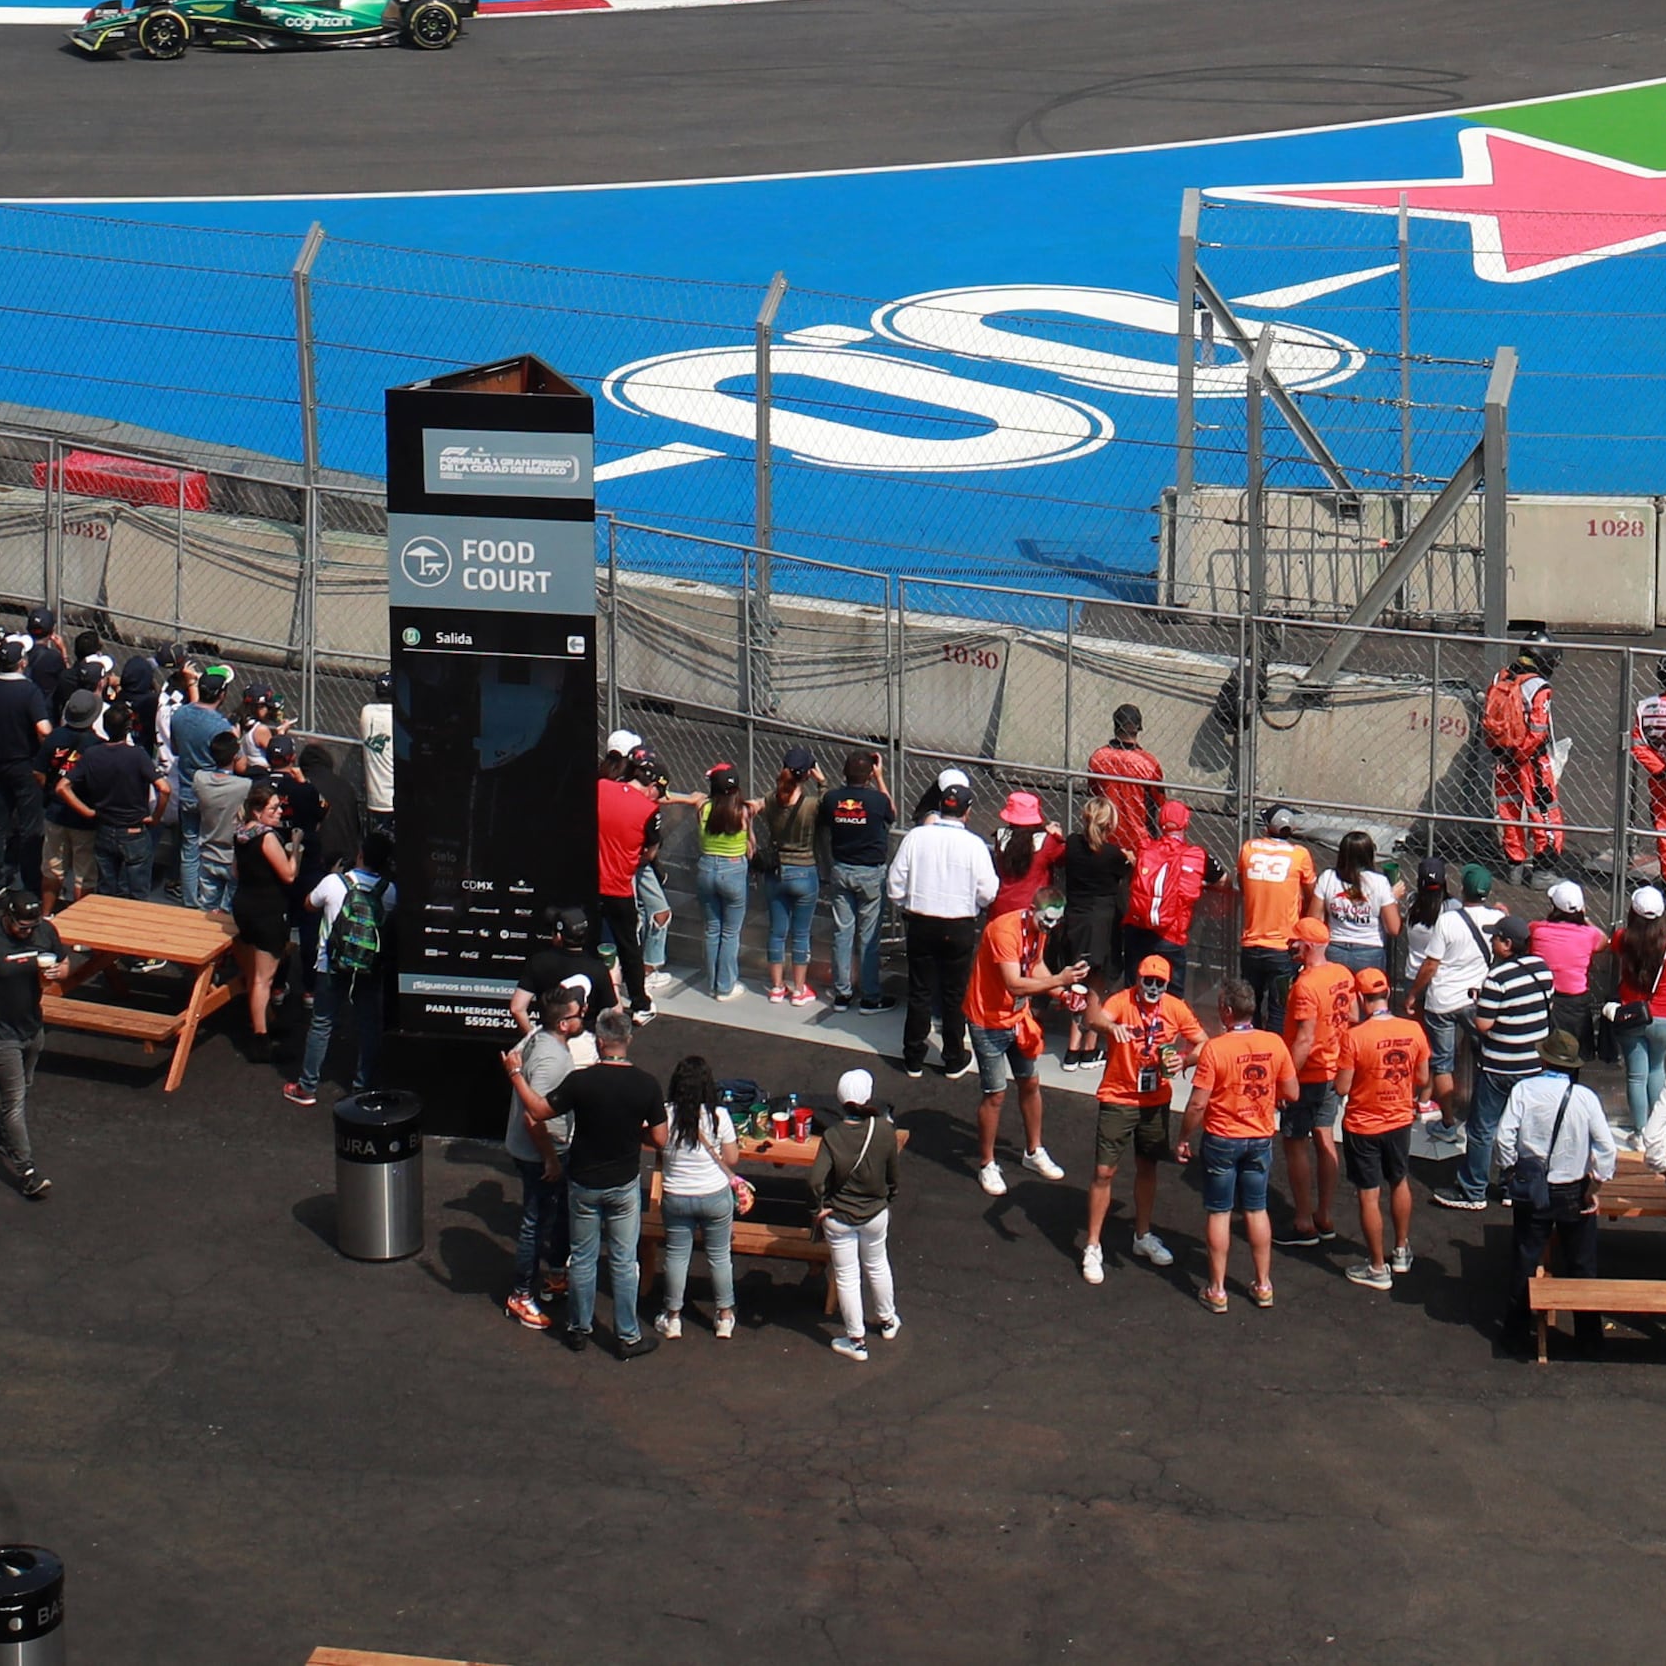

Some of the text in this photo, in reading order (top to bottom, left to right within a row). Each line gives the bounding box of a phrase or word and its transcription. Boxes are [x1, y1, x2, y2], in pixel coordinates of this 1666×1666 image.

[284, 11, 354, 31] cognizant
[440, 456, 490, 466] FORMULA
[500, 458, 531, 468] GRAN
[532, 459, 573, 469] PREMIO
[470, 464, 509, 474] CIUDAD
[1587, 519, 1645, 537] 1028
[463, 538, 536, 565] FOOD
[463, 566, 552, 594] COURT
[435, 629, 473, 646] Salida
[941, 644, 999, 670] 1030
[835, 816, 867, 825] ORACLE
[1247, 852, 1292, 884] 33
[461, 879, 494, 891] CDMX
[460, 983, 473, 993] en
[425, 1004, 452, 1014] PARA
